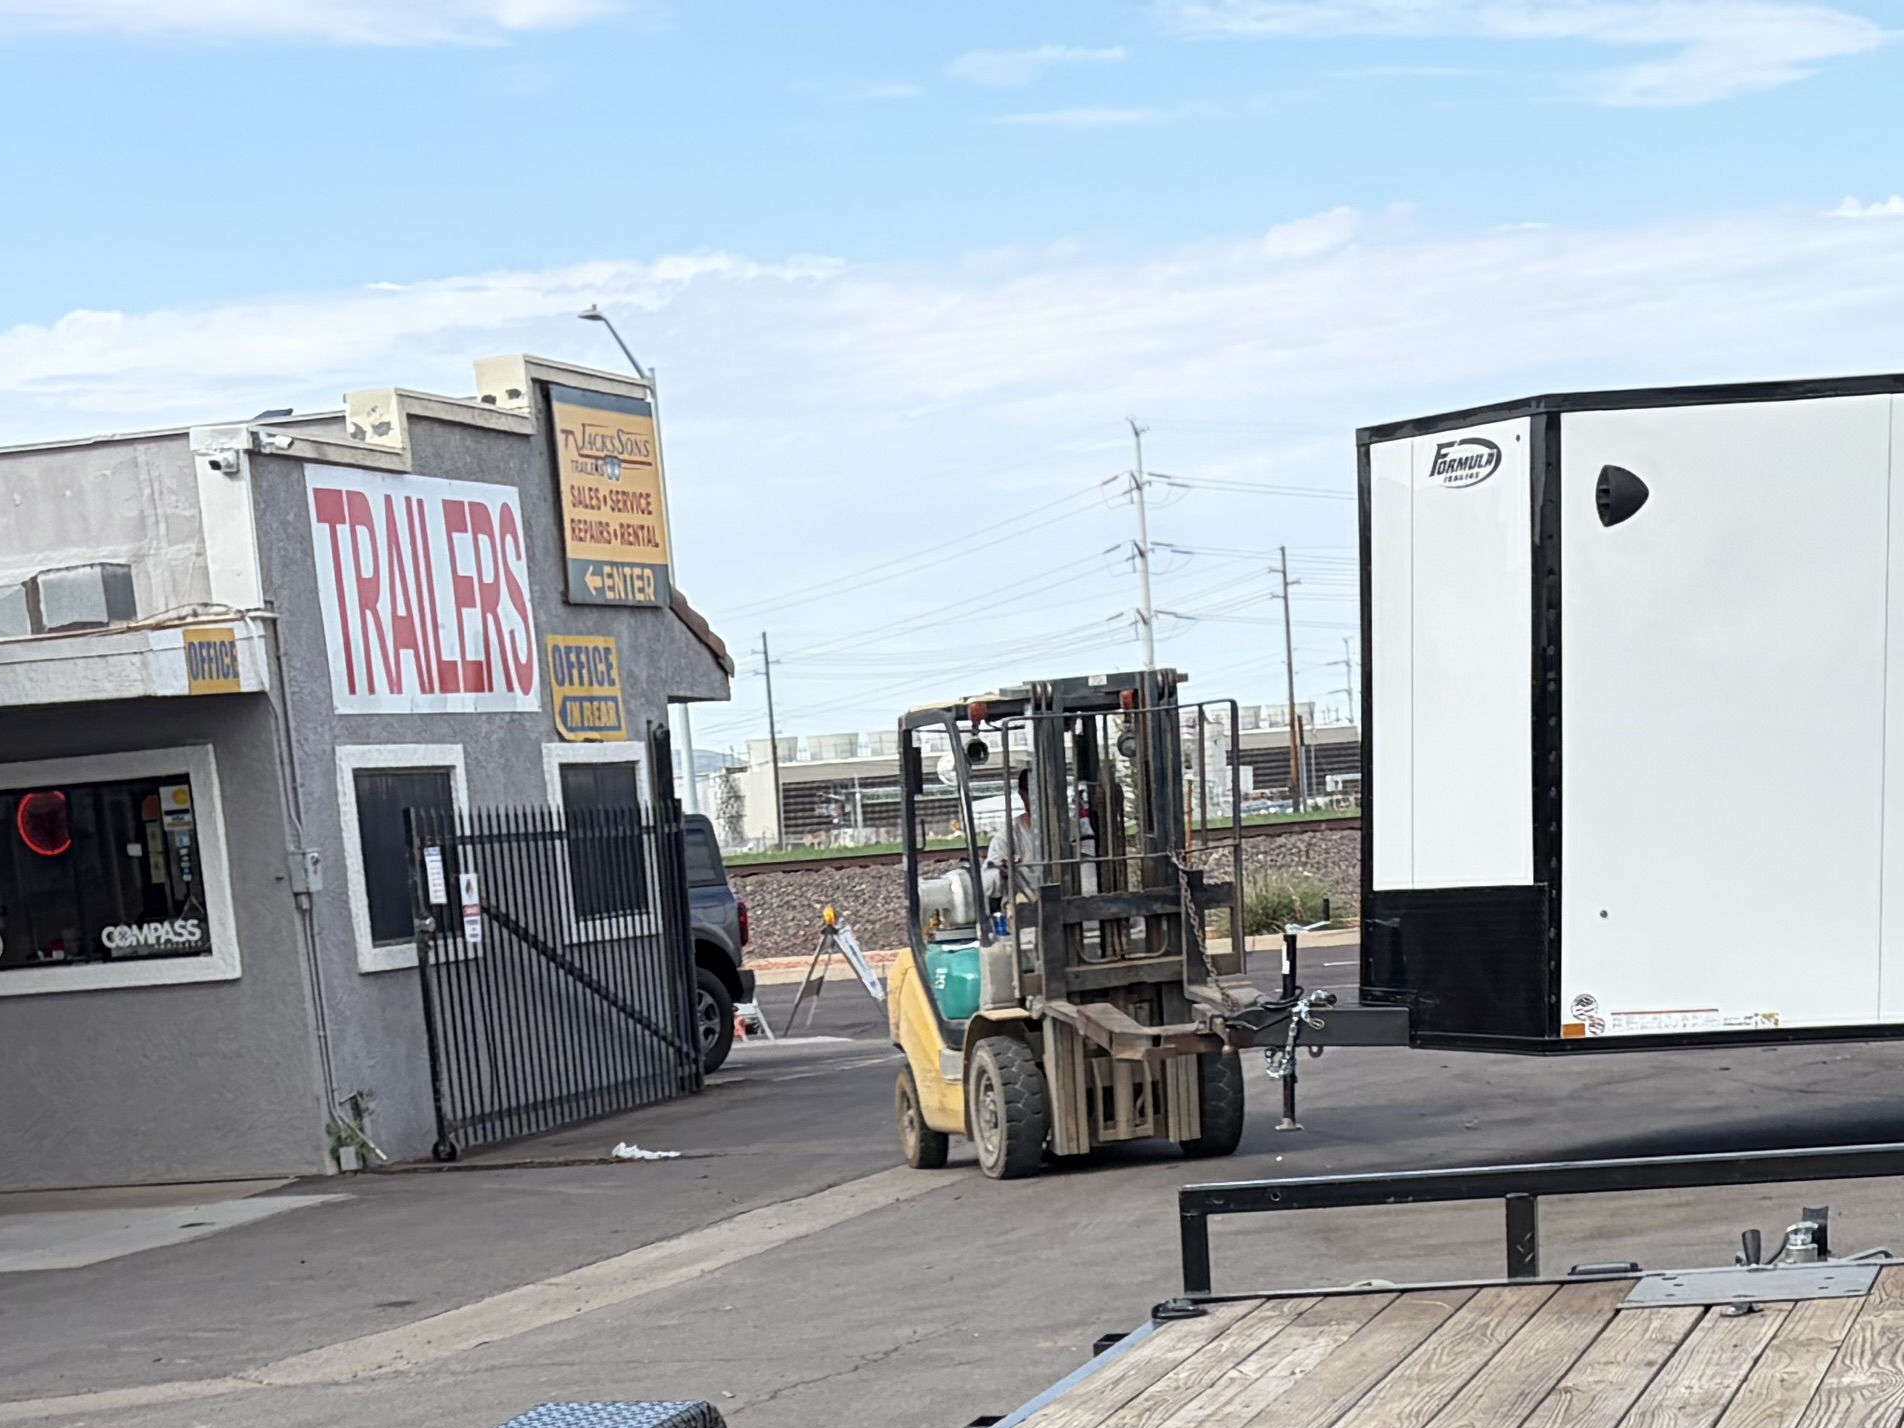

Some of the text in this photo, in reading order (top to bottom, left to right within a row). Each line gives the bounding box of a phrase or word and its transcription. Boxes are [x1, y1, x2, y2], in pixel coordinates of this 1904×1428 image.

[570, 485, 653, 515] SALES SERVICE
[570, 518, 659, 548] REPAIRS RENTAL
[312, 487, 534, 696] TRAILERS
[603, 565, 655, 601] ENTER
[188, 640, 240, 681] OFFICE
[552, 644, 616, 687] OFFICE
[583, 701, 618, 727] REAR
[101, 919, 202, 949] COMPASS
